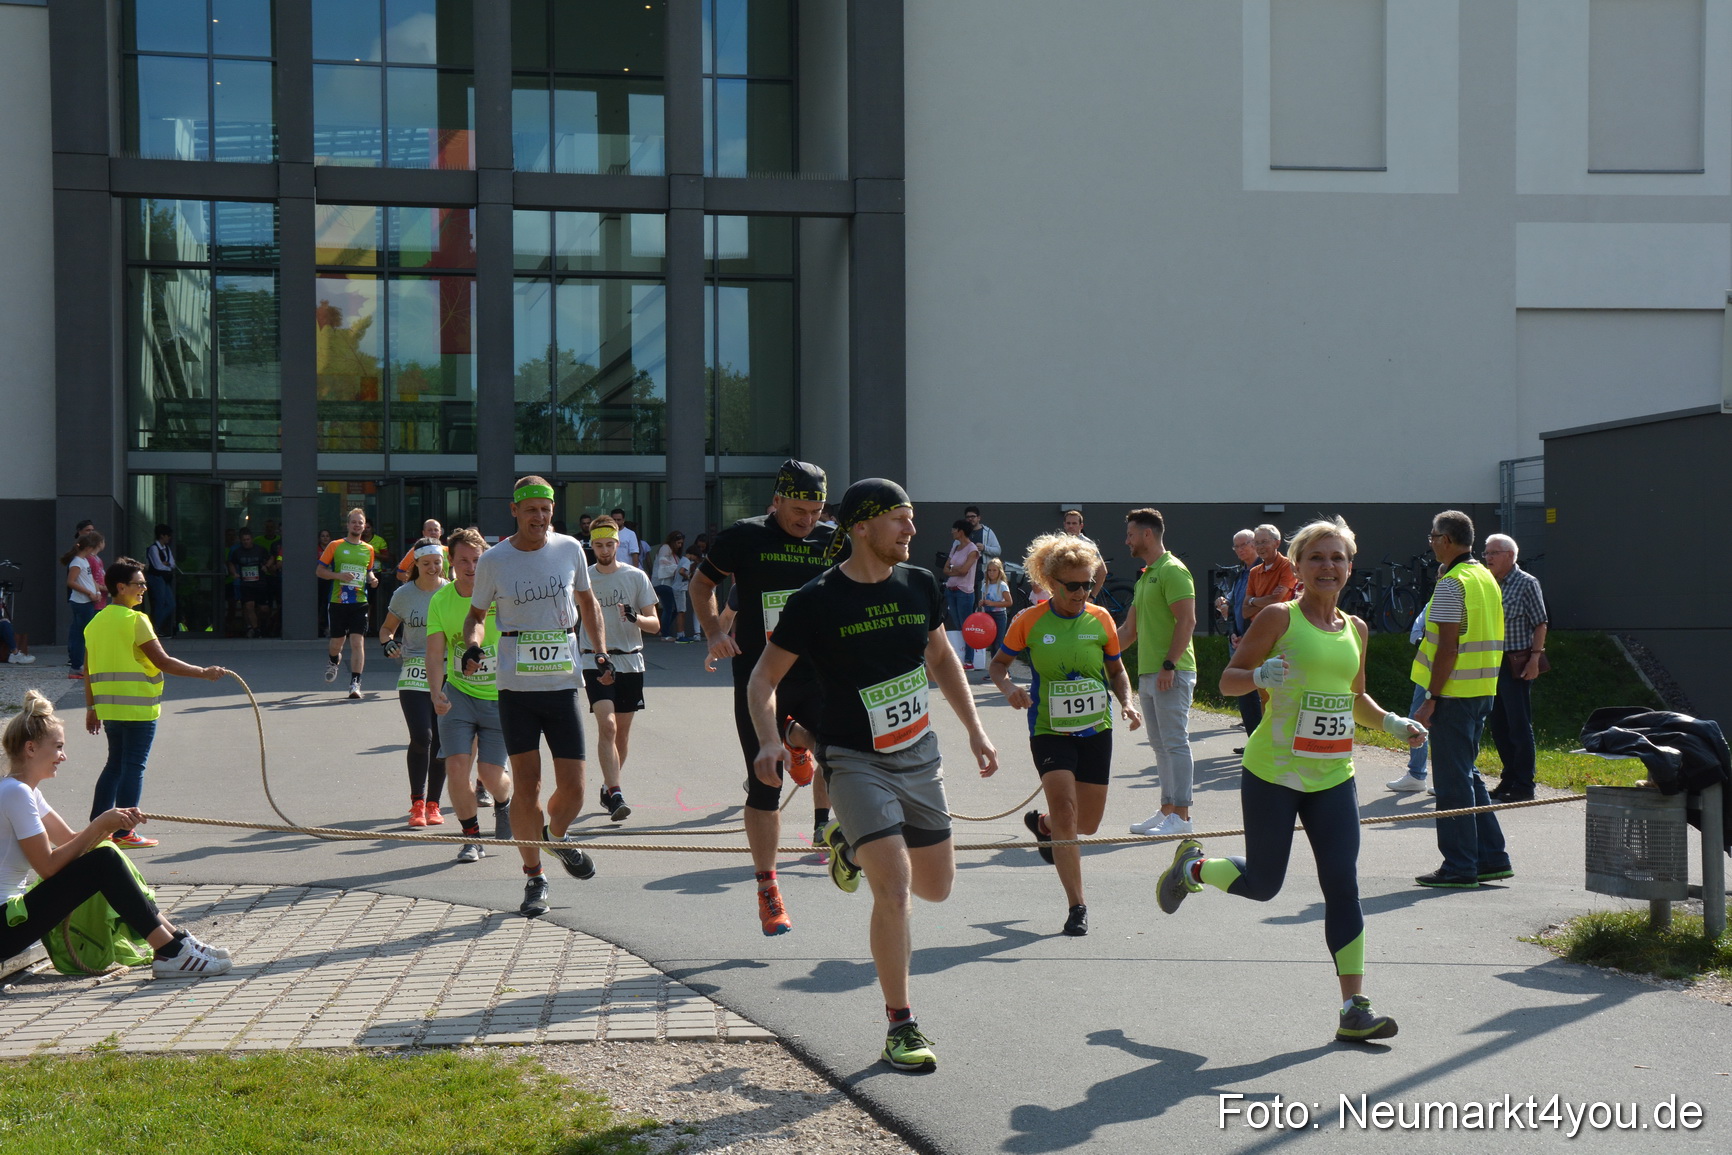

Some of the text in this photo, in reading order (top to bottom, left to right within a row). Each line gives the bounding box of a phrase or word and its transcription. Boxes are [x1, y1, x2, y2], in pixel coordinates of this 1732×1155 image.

[784, 543, 811, 555] TEAM
[760, 552, 805, 564] FORREST
[513, 575, 567, 608] Läuft
[865, 602, 900, 618] TEAM
[840, 613, 926, 638] FORREST GUMP
[521, 631, 565, 643] BOCK
[529, 646, 559, 661] 107
[406, 666, 427, 680] 105
[526, 663, 563, 672] THOMAS
[404, 680, 426, 688] SARAH
[866, 670, 926, 705] BOCK
[1054, 680, 1100, 695] BOCK
[1063, 696, 1094, 714] 191
[1307, 694, 1350, 710] BOCK
[885, 695, 922, 728] 534
[1312, 715, 1347, 737] 535
